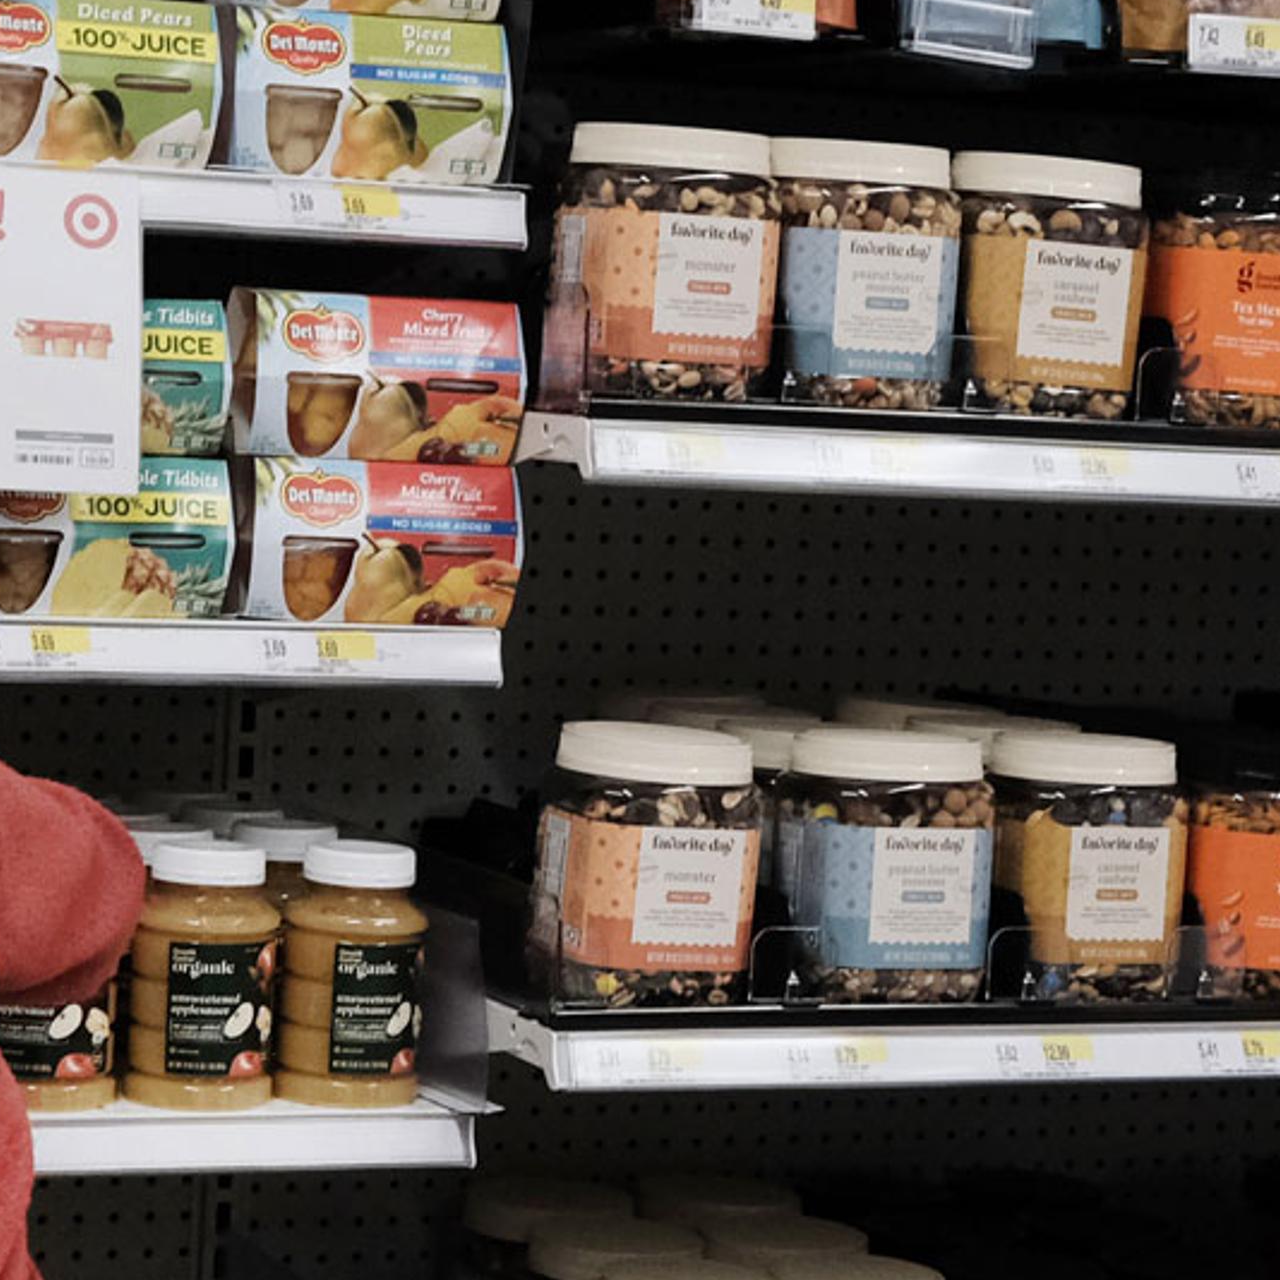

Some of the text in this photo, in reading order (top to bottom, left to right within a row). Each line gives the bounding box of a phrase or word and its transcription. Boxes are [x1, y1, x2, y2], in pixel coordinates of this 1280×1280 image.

[0, 14, 47, 36] Monte
[77, 2, 193, 28] Diced Pears
[131, 32, 206, 56] JUICE
[670, 219, 754, 247] favorite day
[1231, 300, 1257, 316] Tex
[162, 467, 219, 488] Tidbits
[151, 496, 218, 520] JUICE
[651, 834, 735, 856] favorite day
[172, 959, 235, 979] organic
